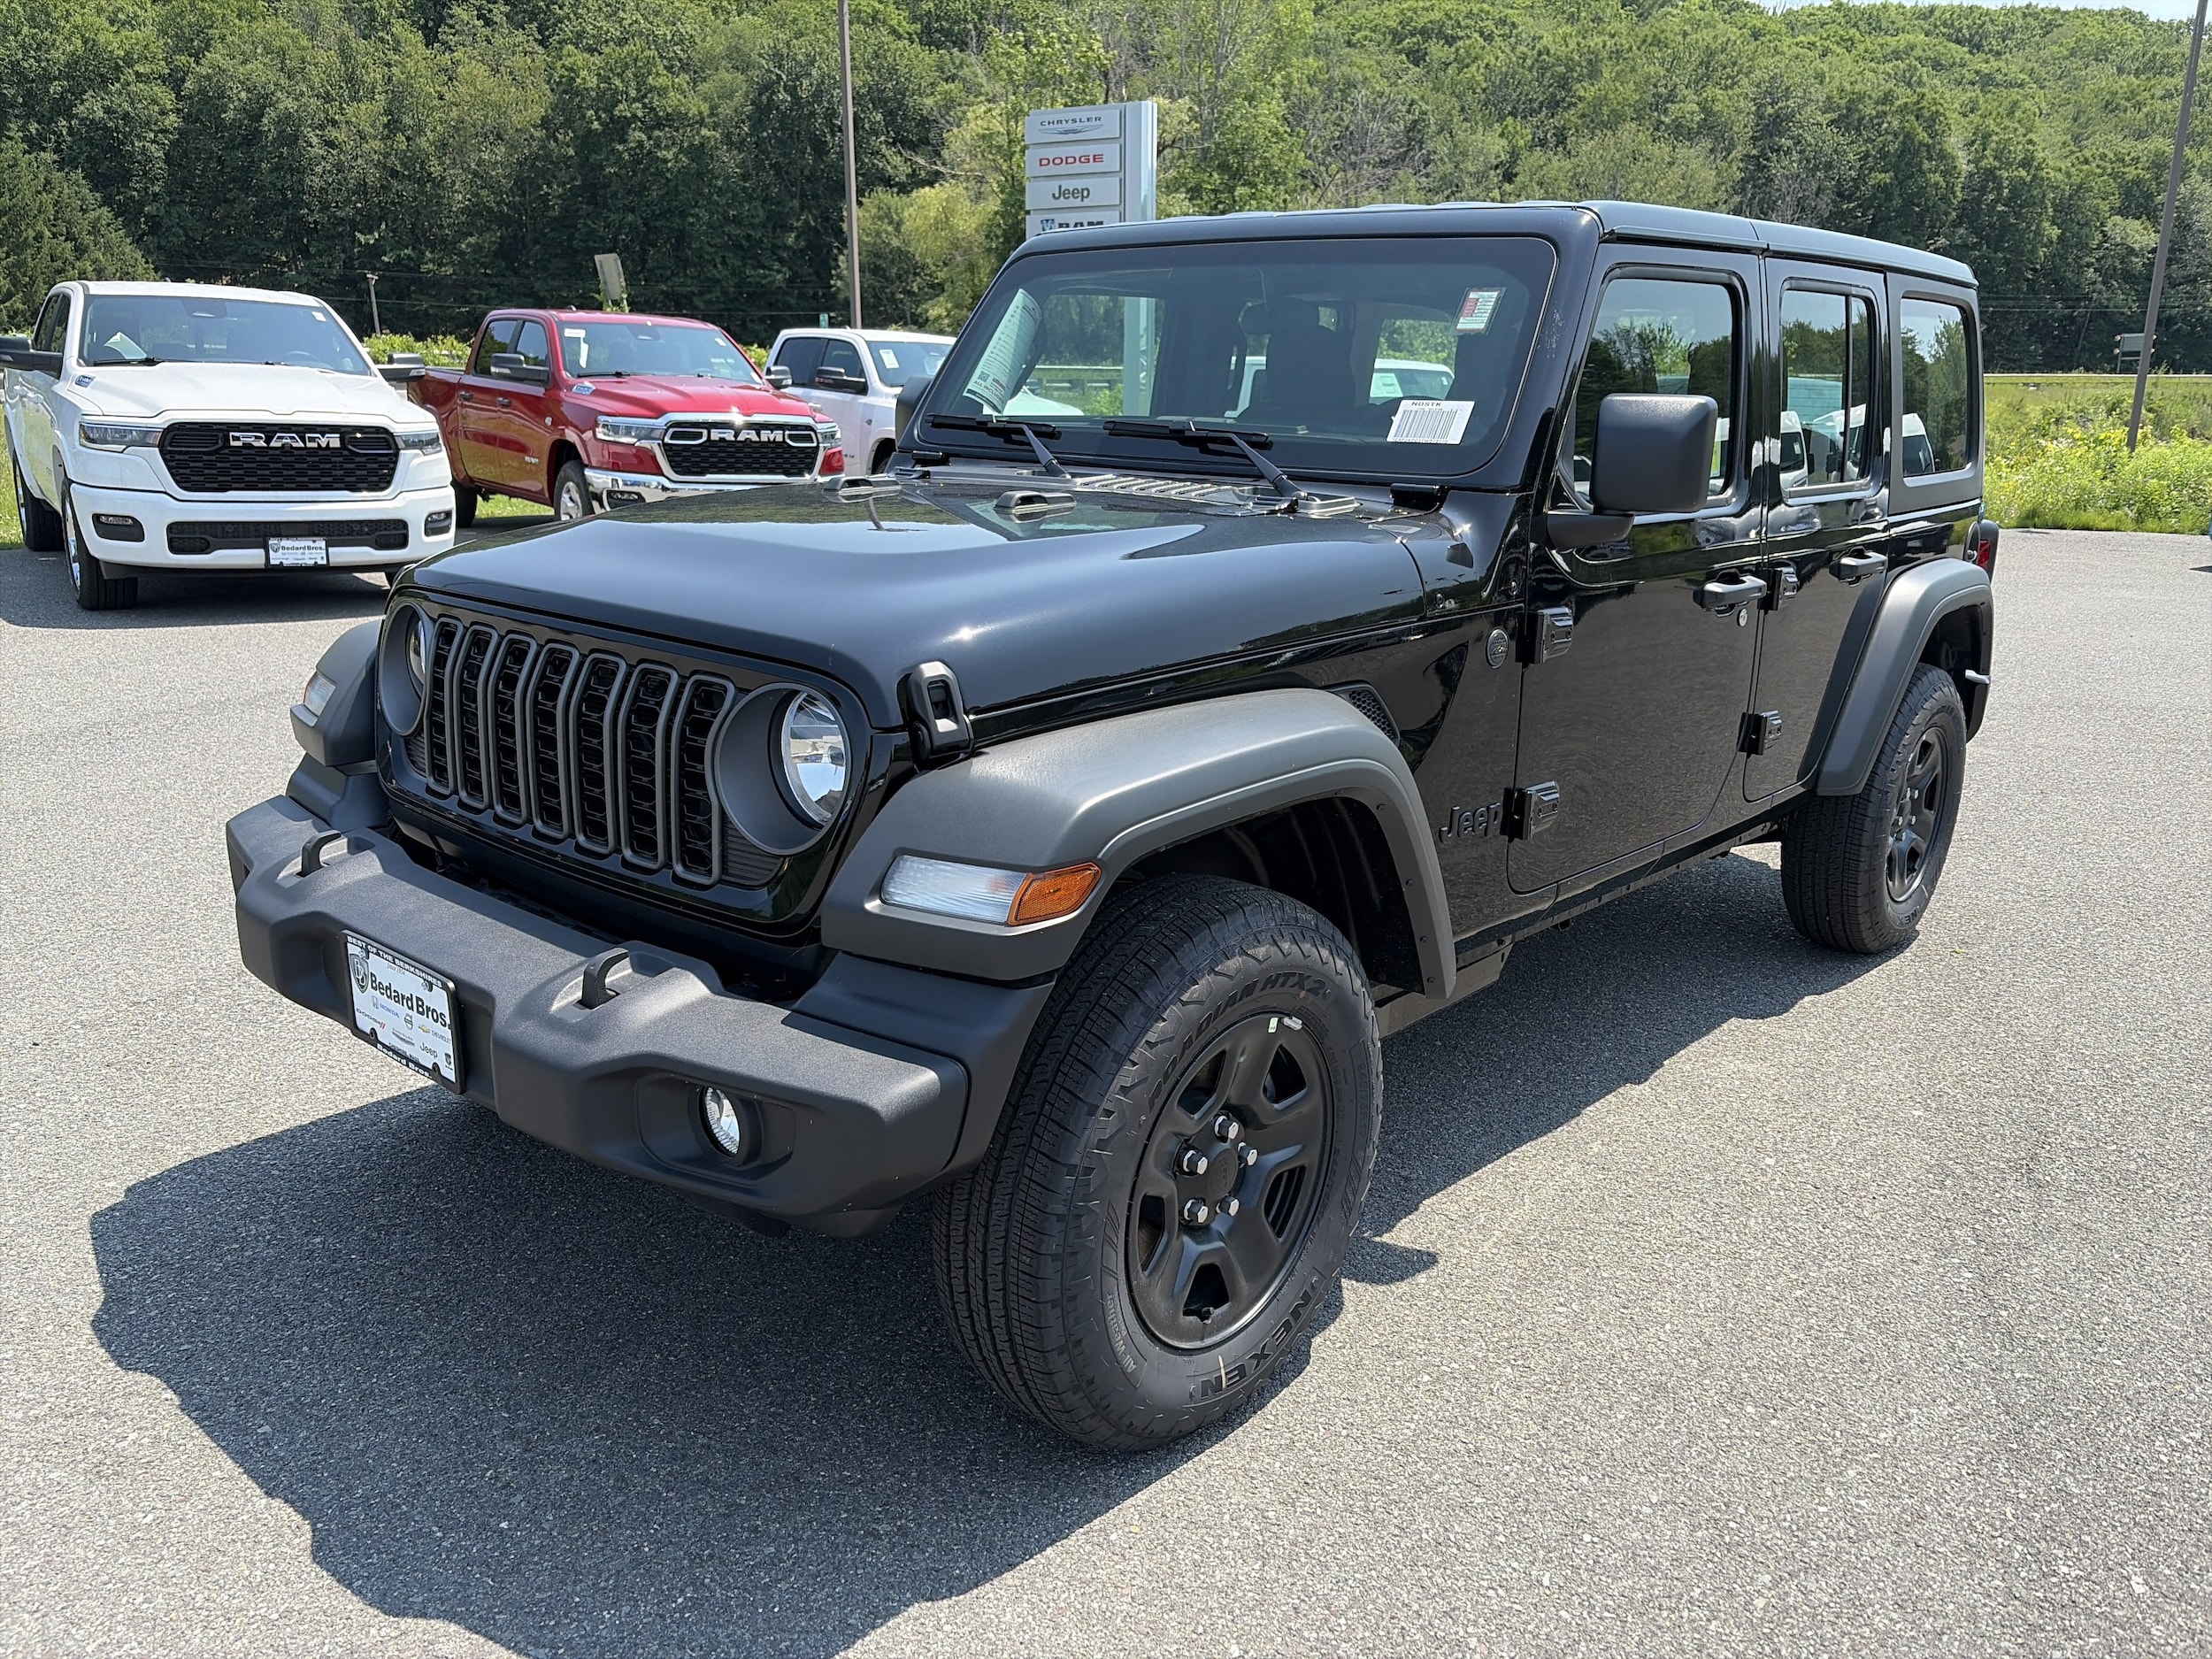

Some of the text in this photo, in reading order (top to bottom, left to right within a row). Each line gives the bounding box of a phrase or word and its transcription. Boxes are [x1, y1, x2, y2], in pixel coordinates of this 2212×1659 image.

[1040, 116, 1102, 127] CHRYSLER
[1039, 153, 1104, 167] DODGE
[1052, 185, 1090, 202] Jeep
[229, 432, 341, 448] RAM
[710, 428, 784, 442] RAM
[1439, 803, 1502, 844] Jeep
[347, 935, 442, 988] BEST OF THE BERKSHIRES
[369, 971, 451, 1031] Bedard Bros.
[376, 1043, 407, 1065] Bedard
[419, 1040, 437, 1060] Jeep
[1148, 978, 1260, 1109] ROADIAN
[1106, 1293, 1136, 1373] All-Weather
[1200, 1288, 1312, 1399] NEXEN
